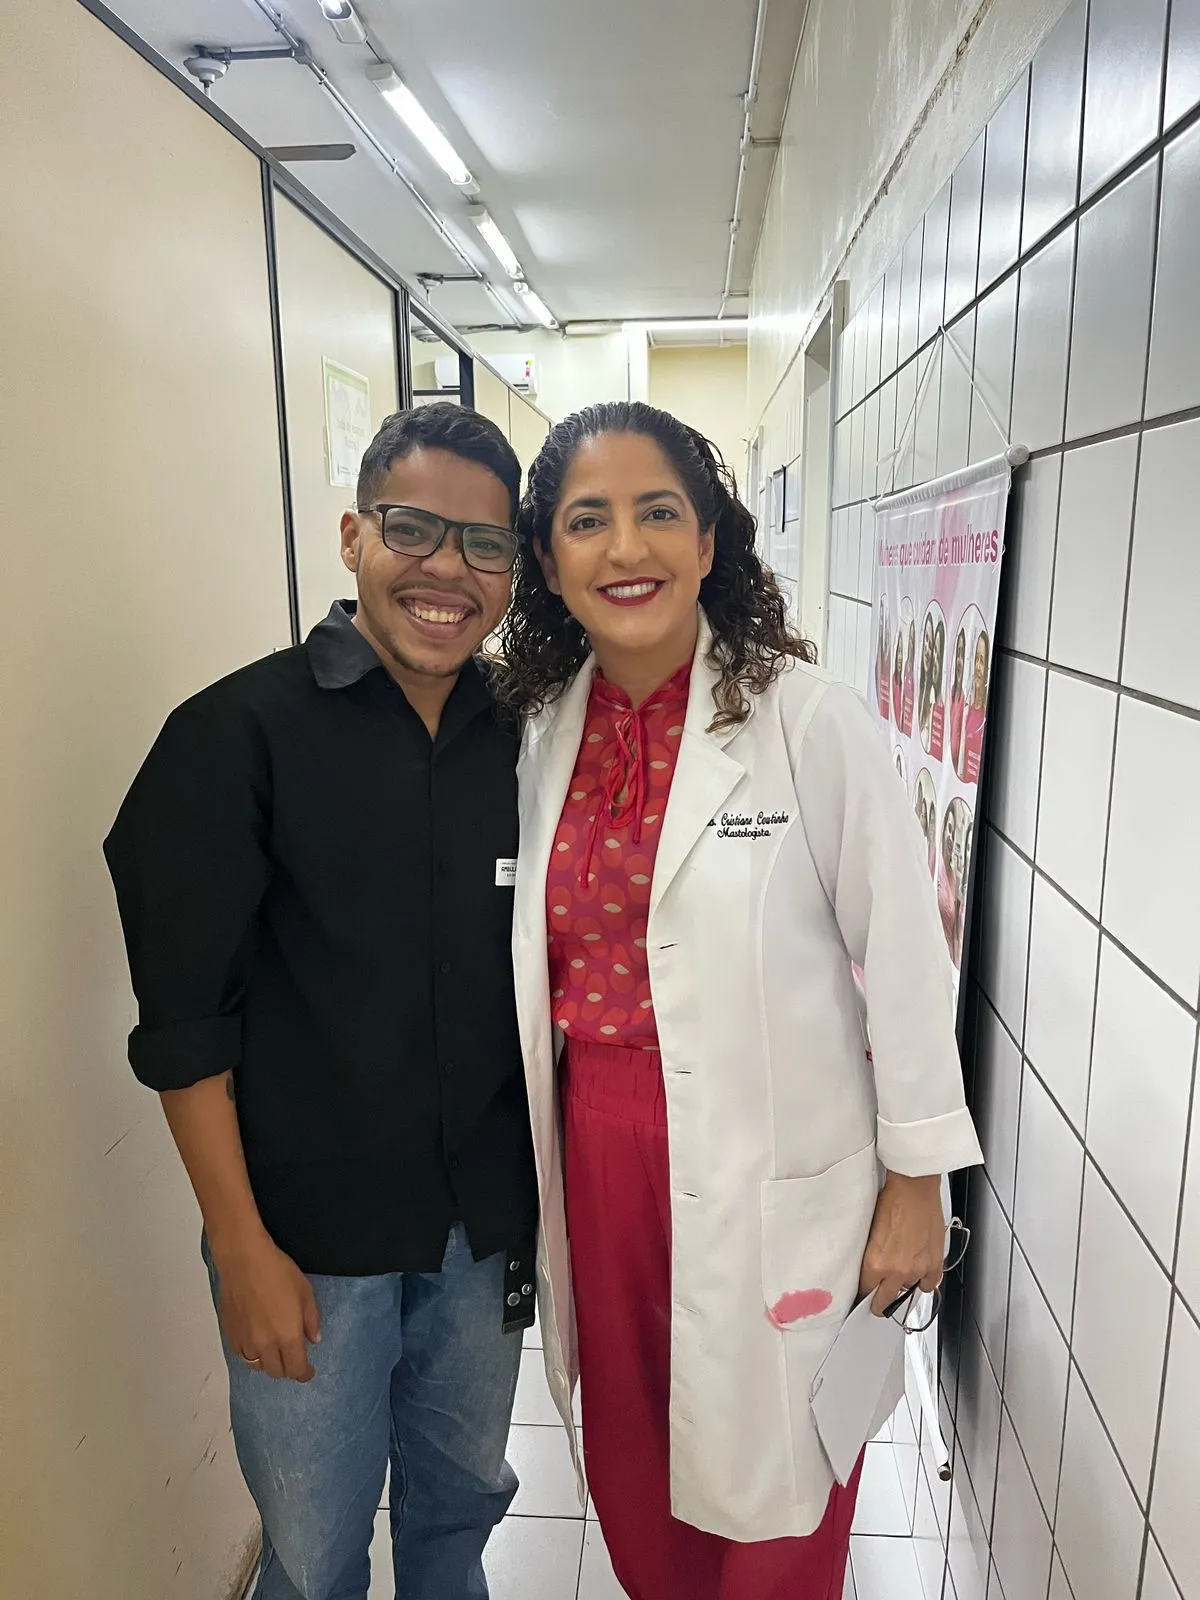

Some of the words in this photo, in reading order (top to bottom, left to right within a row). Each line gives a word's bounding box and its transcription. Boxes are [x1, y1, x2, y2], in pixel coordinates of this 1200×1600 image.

[900, 543, 912, 573] que
[939, 528, 949, 563] de
[951, 522, 999, 563] mulheres
[721, 812, 753, 826] Cristiane
[757, 811, 789, 825] Coutinho
[716, 827, 771, 840] Mastologista
